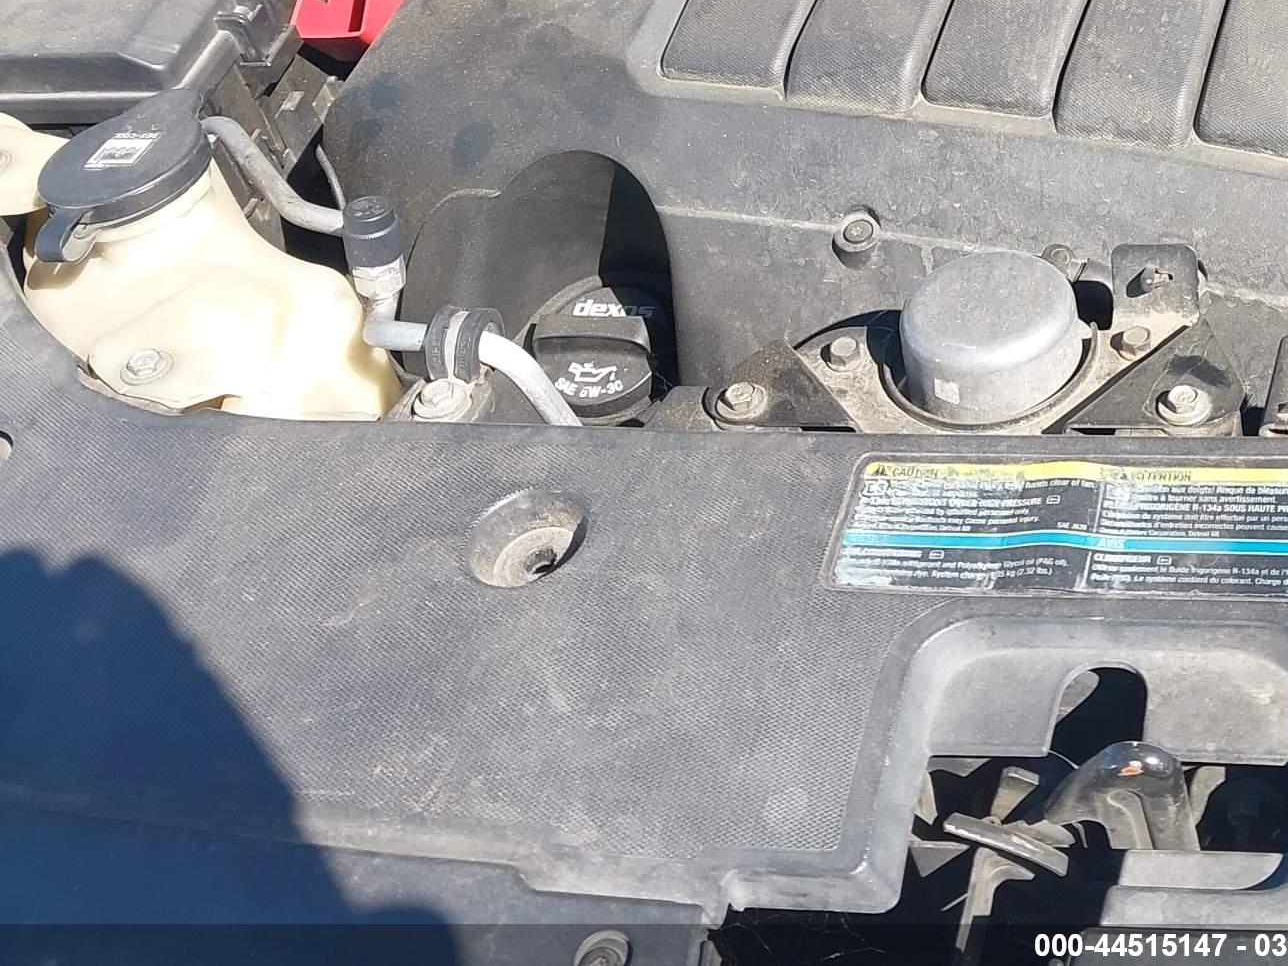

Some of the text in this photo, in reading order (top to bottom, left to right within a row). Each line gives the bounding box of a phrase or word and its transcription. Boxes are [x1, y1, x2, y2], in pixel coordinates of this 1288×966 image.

[572, 298, 657, 318] dexos
[554, 377, 579, 396] SAE
[1049, 479, 1070, 487] clear
[1170, 486, 1187, 494] aux
[1188, 486, 1214, 496] doigts!
[1215, 486, 1244, 496] Risque
[1245, 487, 1256, 495] de
[1167, 494, 1198, 503] tourner
[1218, 495, 1277, 504] avertissement.
[1192, 503, 1222, 512] R-134a
[1223, 504, 1247, 512] SOUS
[1247, 504, 1276, 513] HAUTE
[1018, 516, 1040, 524] injury.
[1246, 516, 1259, 524] par
[1056, 522, 1071, 530] SAE
[1235, 523, 1264, 531] peuvent
[1097, 537, 1125, 548] AVIS
[1003, 558, 1025, 568] Glycol
[930, 570, 959, 579] System
[1232, 567, 1260, 575] R-134a
[1133, 574, 1145, 583] Le
[1209, 576, 1219, 584] du
[1220, 576, 1254, 585] colorant.
[1254, 577, 1282, 587] Charge
